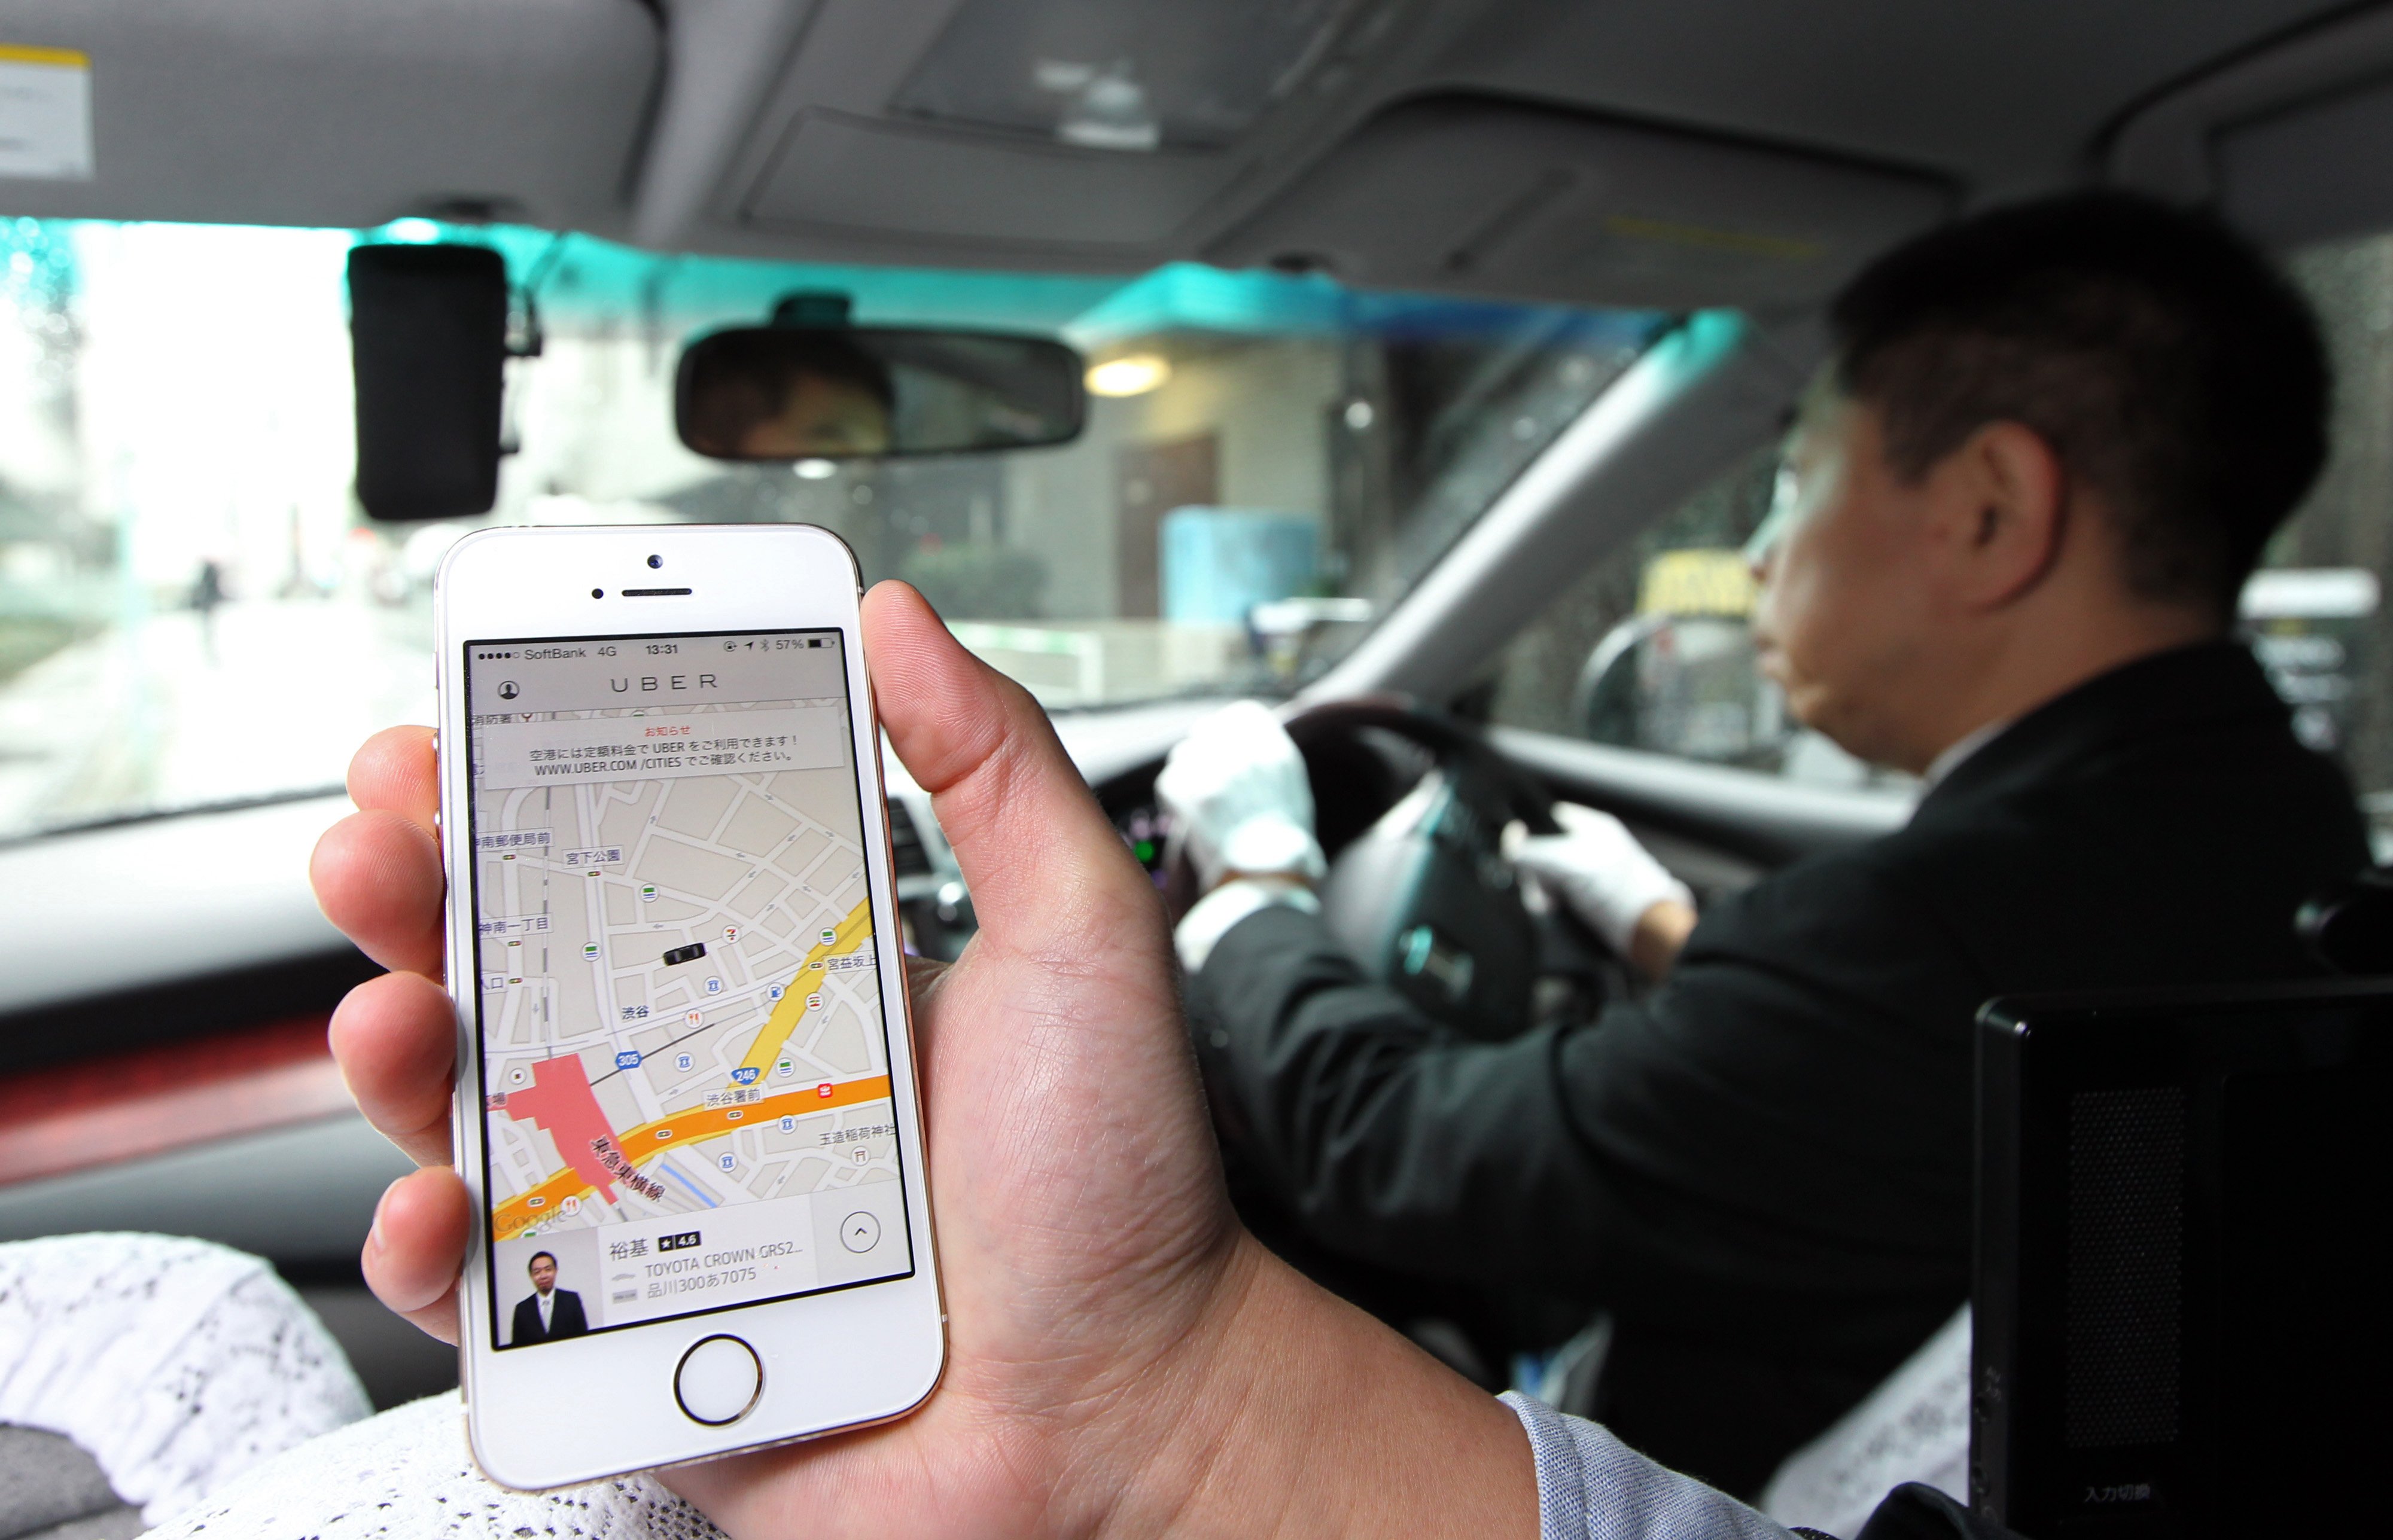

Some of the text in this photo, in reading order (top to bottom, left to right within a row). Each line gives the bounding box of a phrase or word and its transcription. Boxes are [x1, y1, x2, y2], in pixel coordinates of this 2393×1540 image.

[525, 639, 803, 660] SoftBank 4G 13:31 57%
[610, 674, 718, 692] UBER
[645, 725, 690, 737] お知らせ
[529, 744, 649, 761] 空港には定額料金で
[653, 742, 685, 753] UBER
[685, 751, 791, 766] でご確認ください。
[566, 849, 620, 865] 宮下公園
[828, 955, 876, 970] 宮益坂上
[622, 1005, 650, 1020] 渋谷
[617, 1054, 640, 1066] 305
[736, 1069, 756, 1080] 246
[707, 1088, 760, 1106] 渋谷署前
[590, 1135, 665, 1202] 東急東横線
[494, 1206, 566, 1232] Google
[609, 1234, 697, 1261] 裕基 4.6
[645, 1258, 700, 1278] TOYOTA
[704, 1248, 755, 1267] CROWN
[647, 1267, 756, 1298] 品川300あ7075
